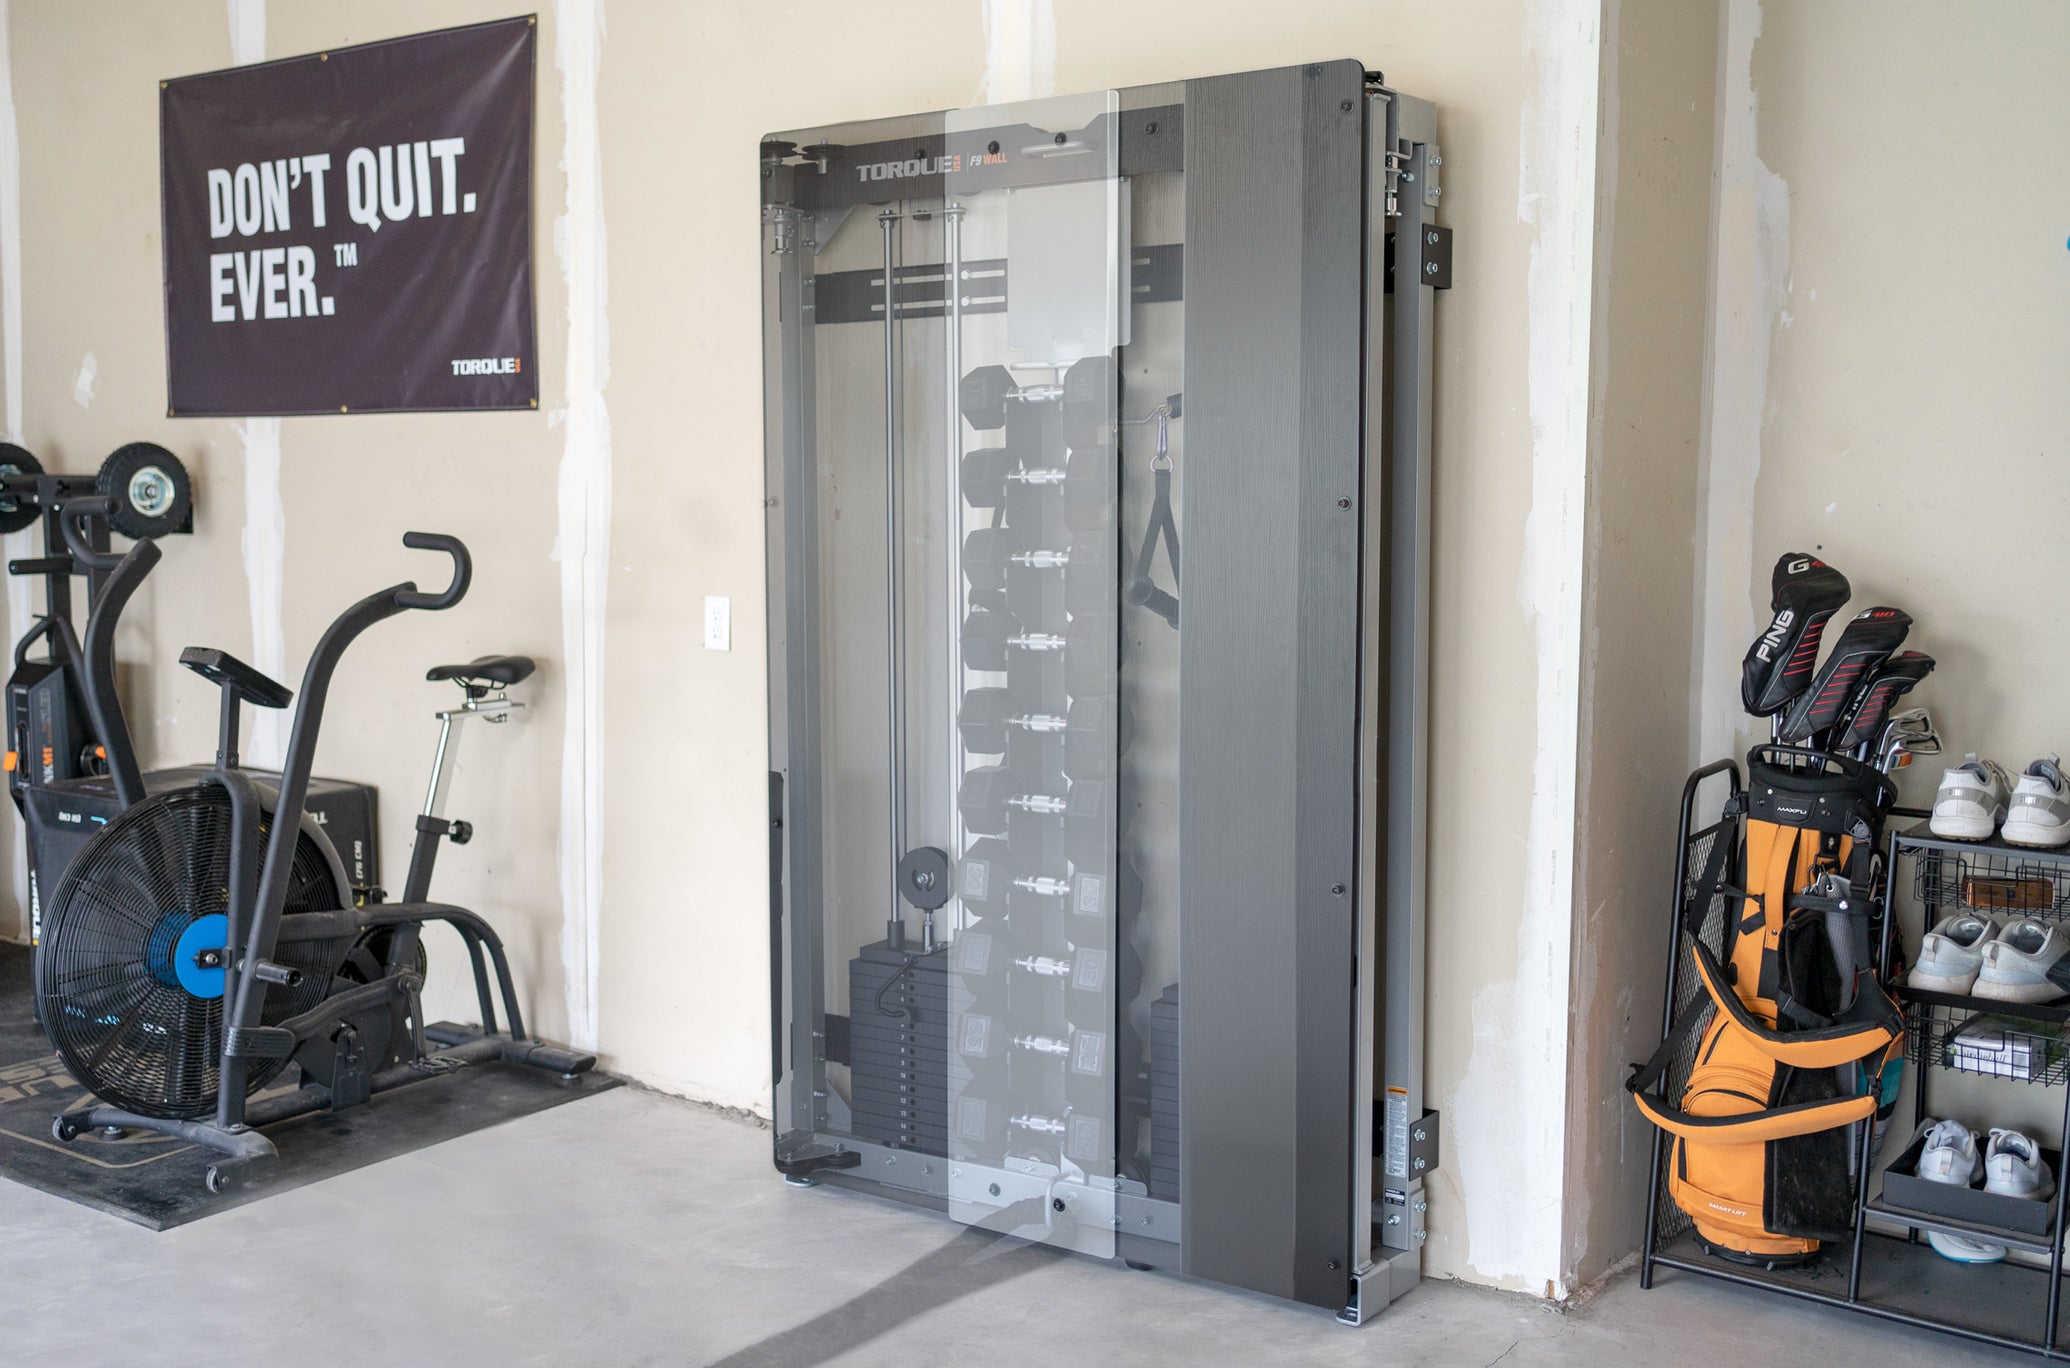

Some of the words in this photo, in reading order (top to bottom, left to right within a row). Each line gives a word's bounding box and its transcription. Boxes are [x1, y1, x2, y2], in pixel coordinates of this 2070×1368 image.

[856, 155, 952, 183] TORQUE
[952, 154, 962, 173] USA
[969, 155, 982, 167] F9
[982, 152, 1008, 165] WALL
[208, 153, 331, 239] DON'T
[347, 137, 477, 234] QUIT.
[210, 245, 336, 322] EVER.
[451, 357, 516, 376] TORQUE
[1755, 609, 1795, 663] PING
[1709, 1202, 1731, 1212] SMART
[1731, 1209, 1746, 1217] LIFT
